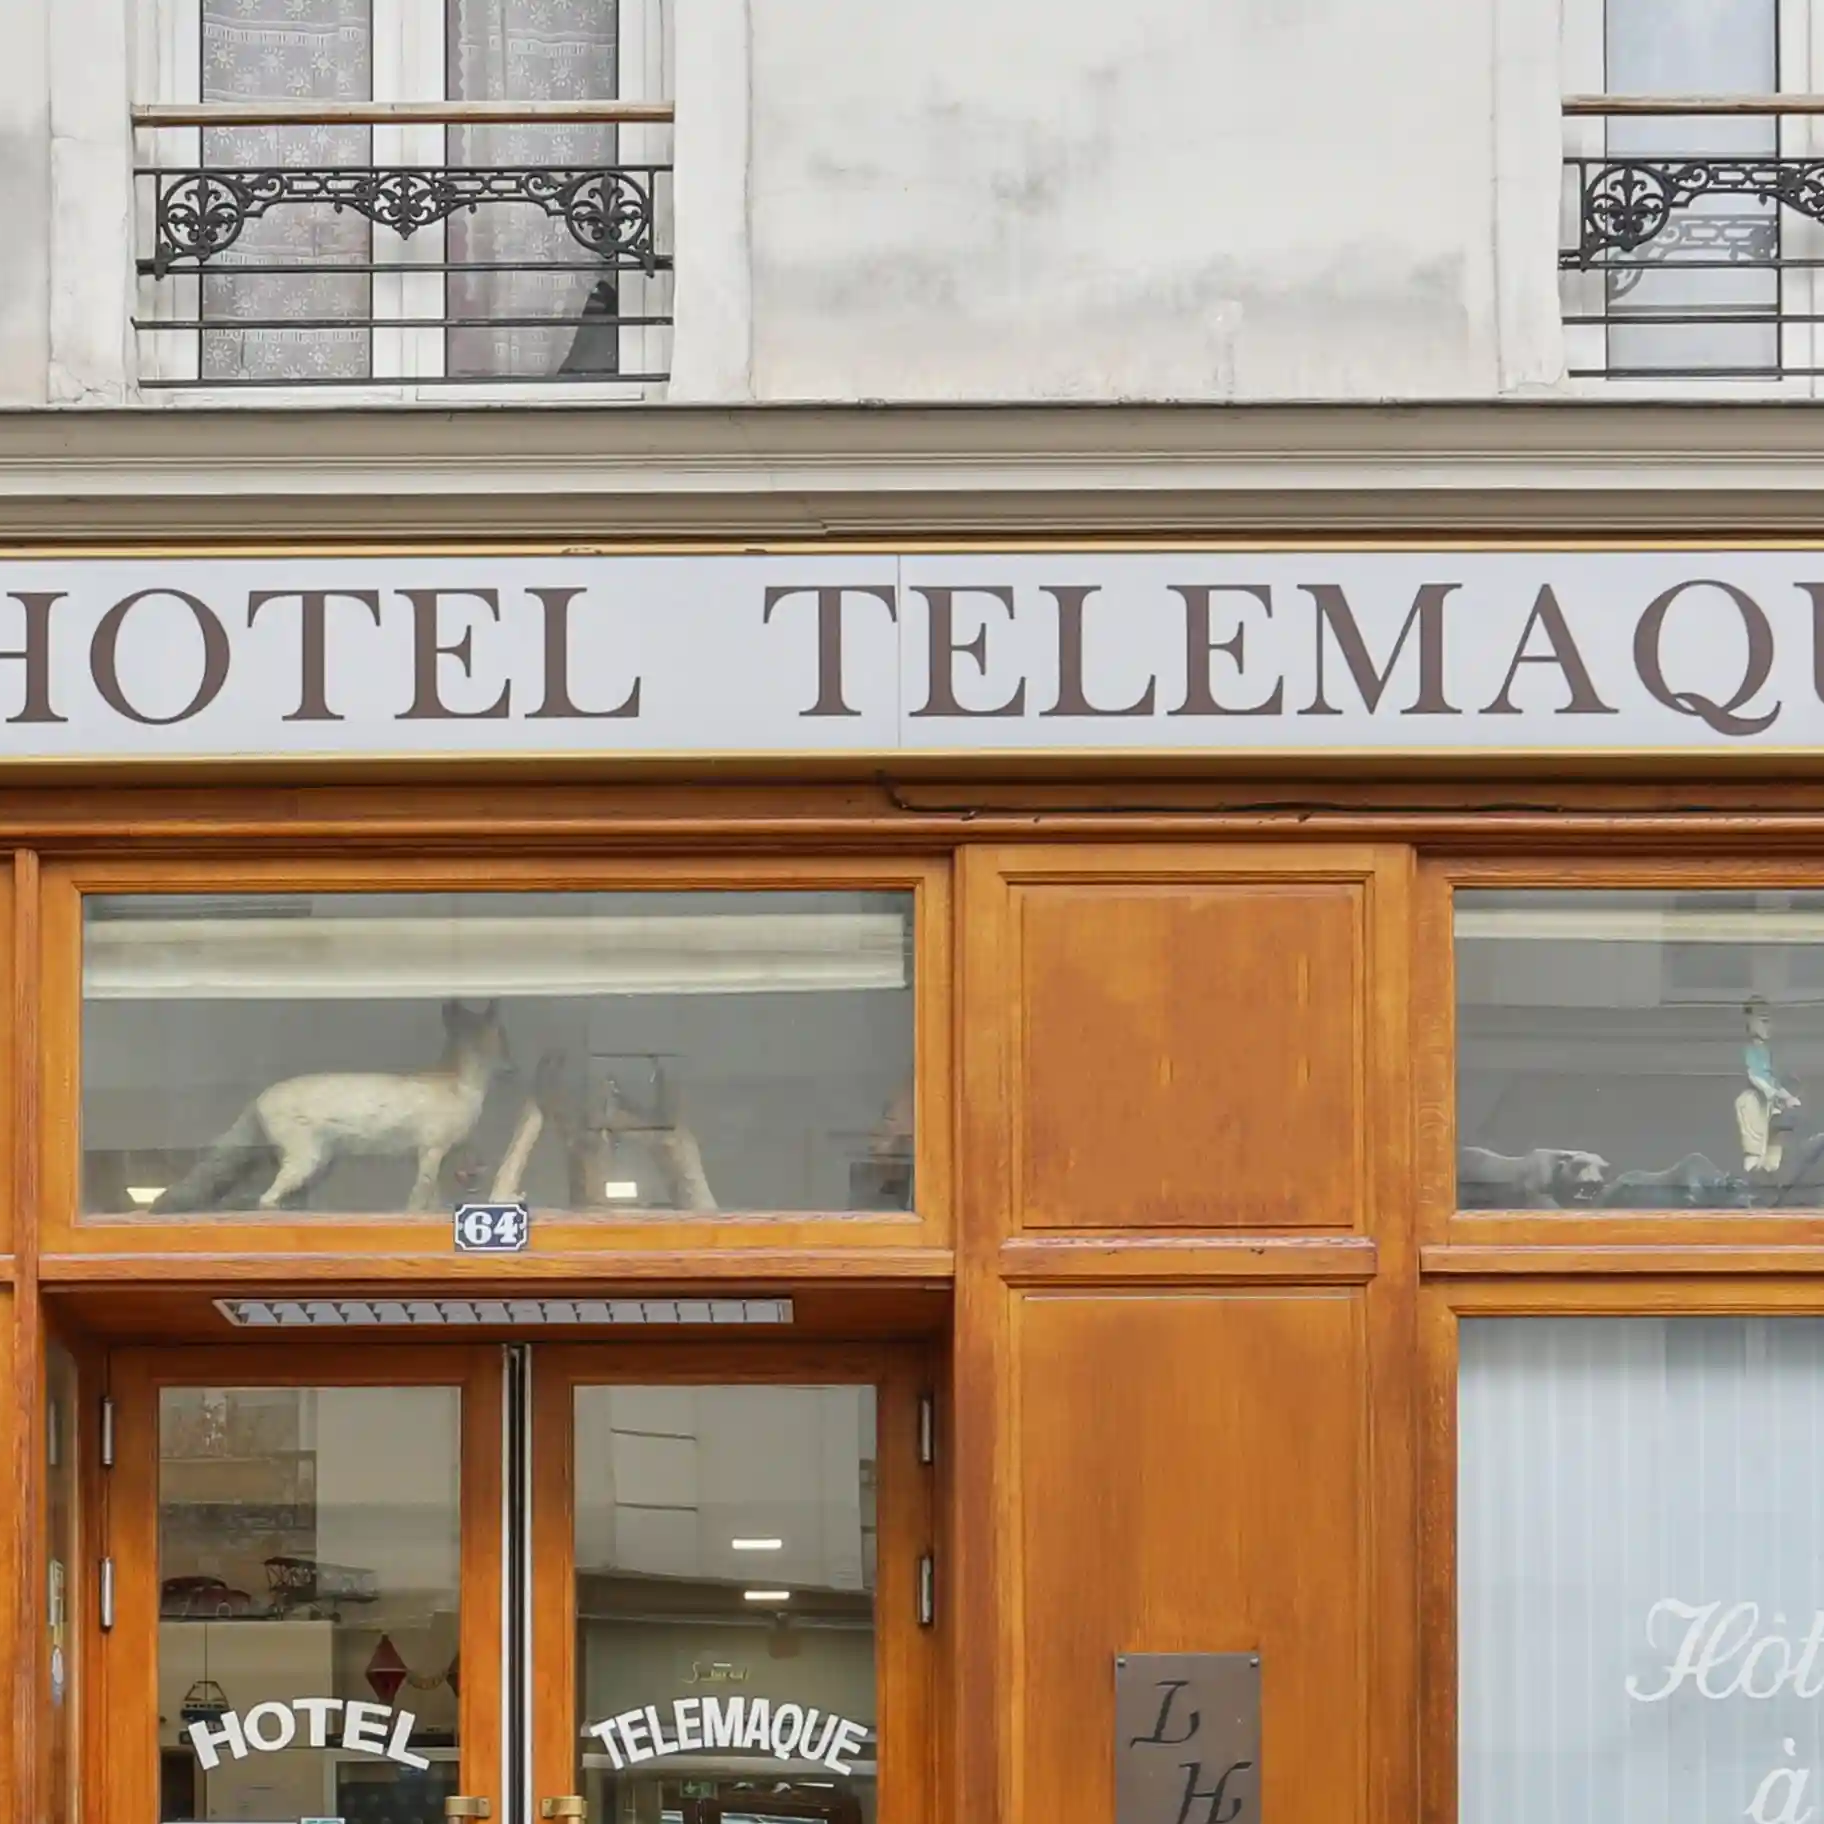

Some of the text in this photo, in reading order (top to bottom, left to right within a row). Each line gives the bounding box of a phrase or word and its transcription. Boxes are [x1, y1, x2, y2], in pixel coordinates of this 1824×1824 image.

[463, 1211, 519, 1245] 64
[187, 1697, 431, 1771] HOTEL
[588, 1696, 869, 1777] TELEMAQUE
[1129, 1679, 1201, 1749] L
